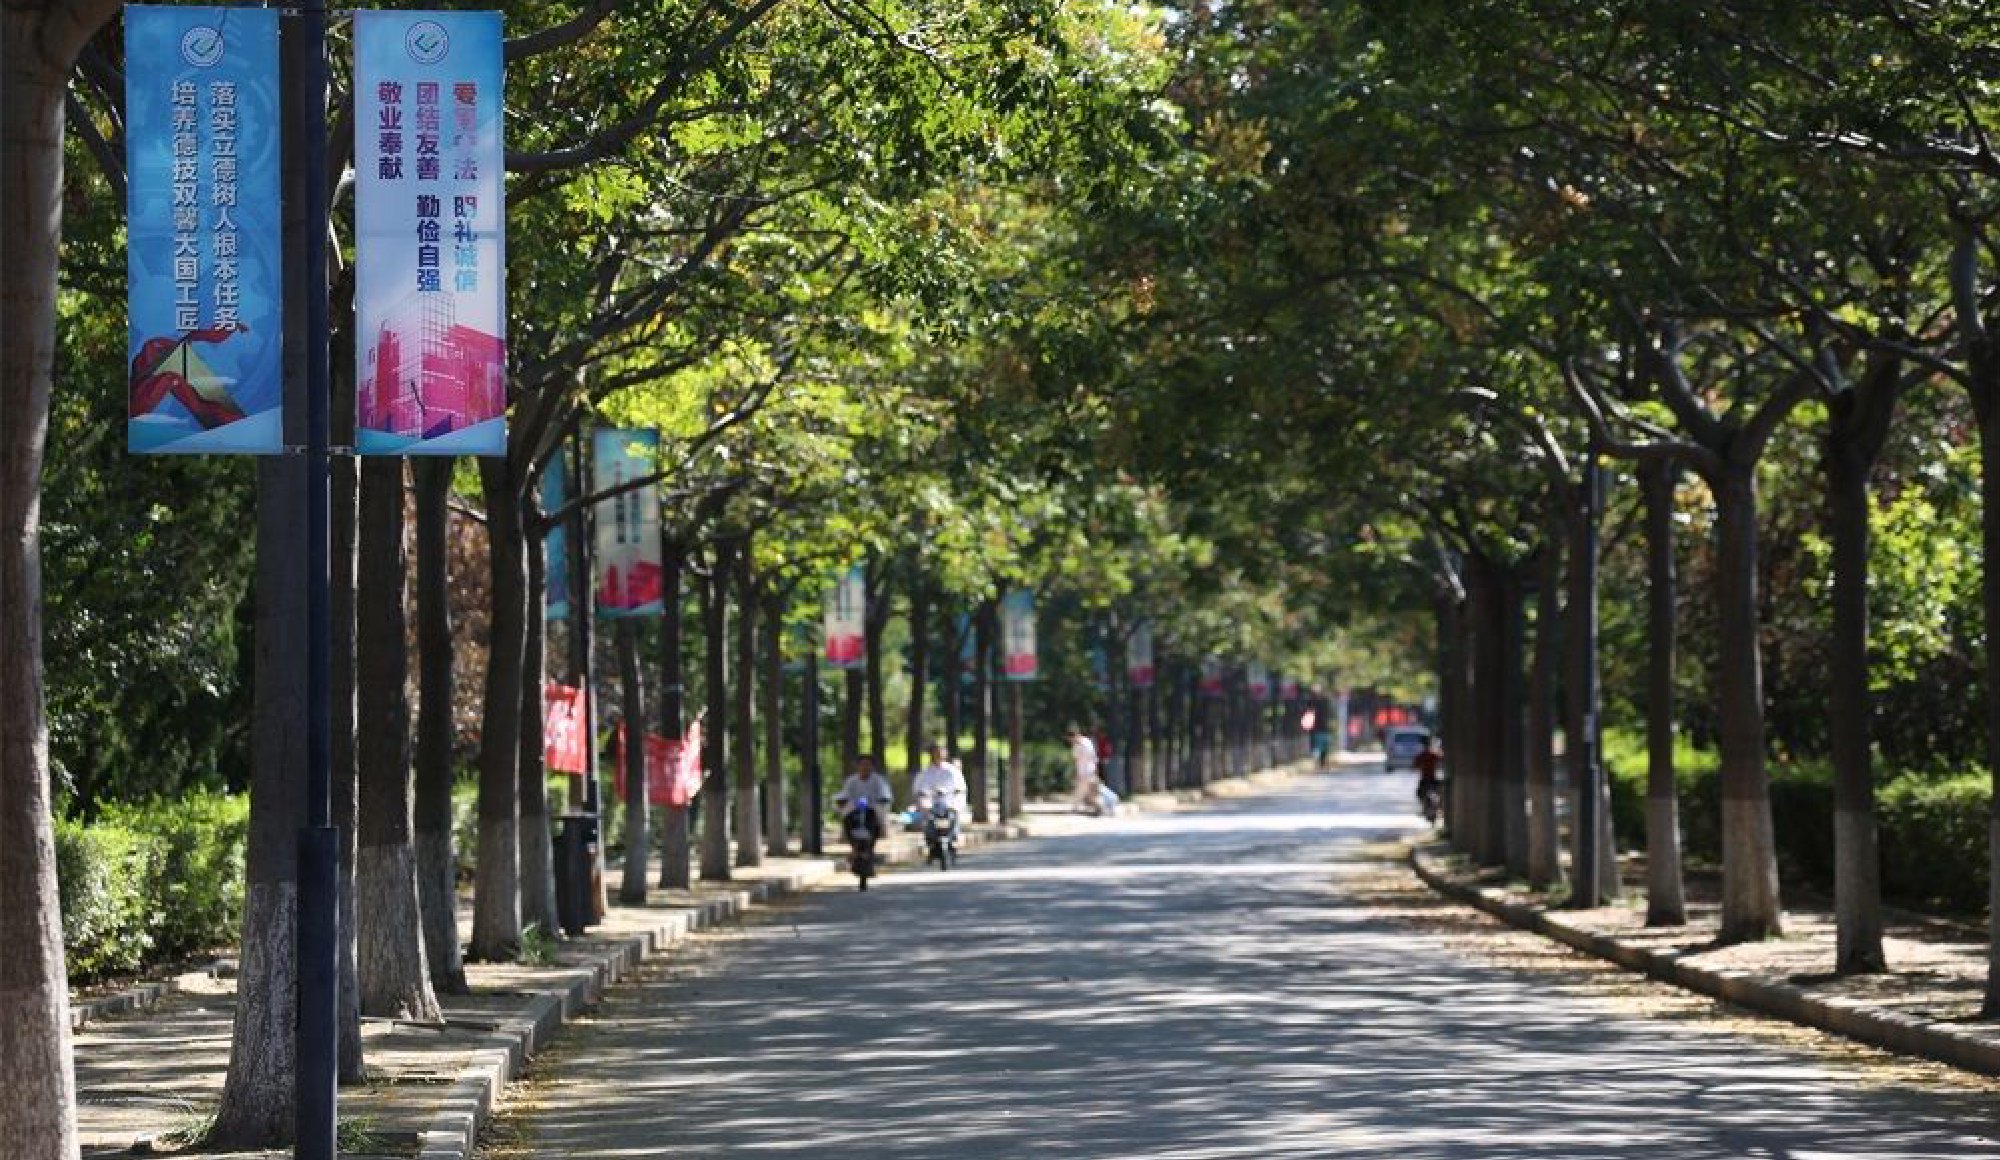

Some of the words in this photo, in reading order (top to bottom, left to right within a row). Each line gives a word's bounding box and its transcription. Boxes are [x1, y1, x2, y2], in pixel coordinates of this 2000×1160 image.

[378, 81, 403, 180] 敬业奉献
[416, 81, 440, 181] 团结友善
[452, 81, 478, 180] 爱法
[172, 79, 199, 331] 培养德技双馨大国工匠
[210, 81, 239, 332] 落实立德树人根本任务
[416, 194, 441, 292] 勤俭自强
